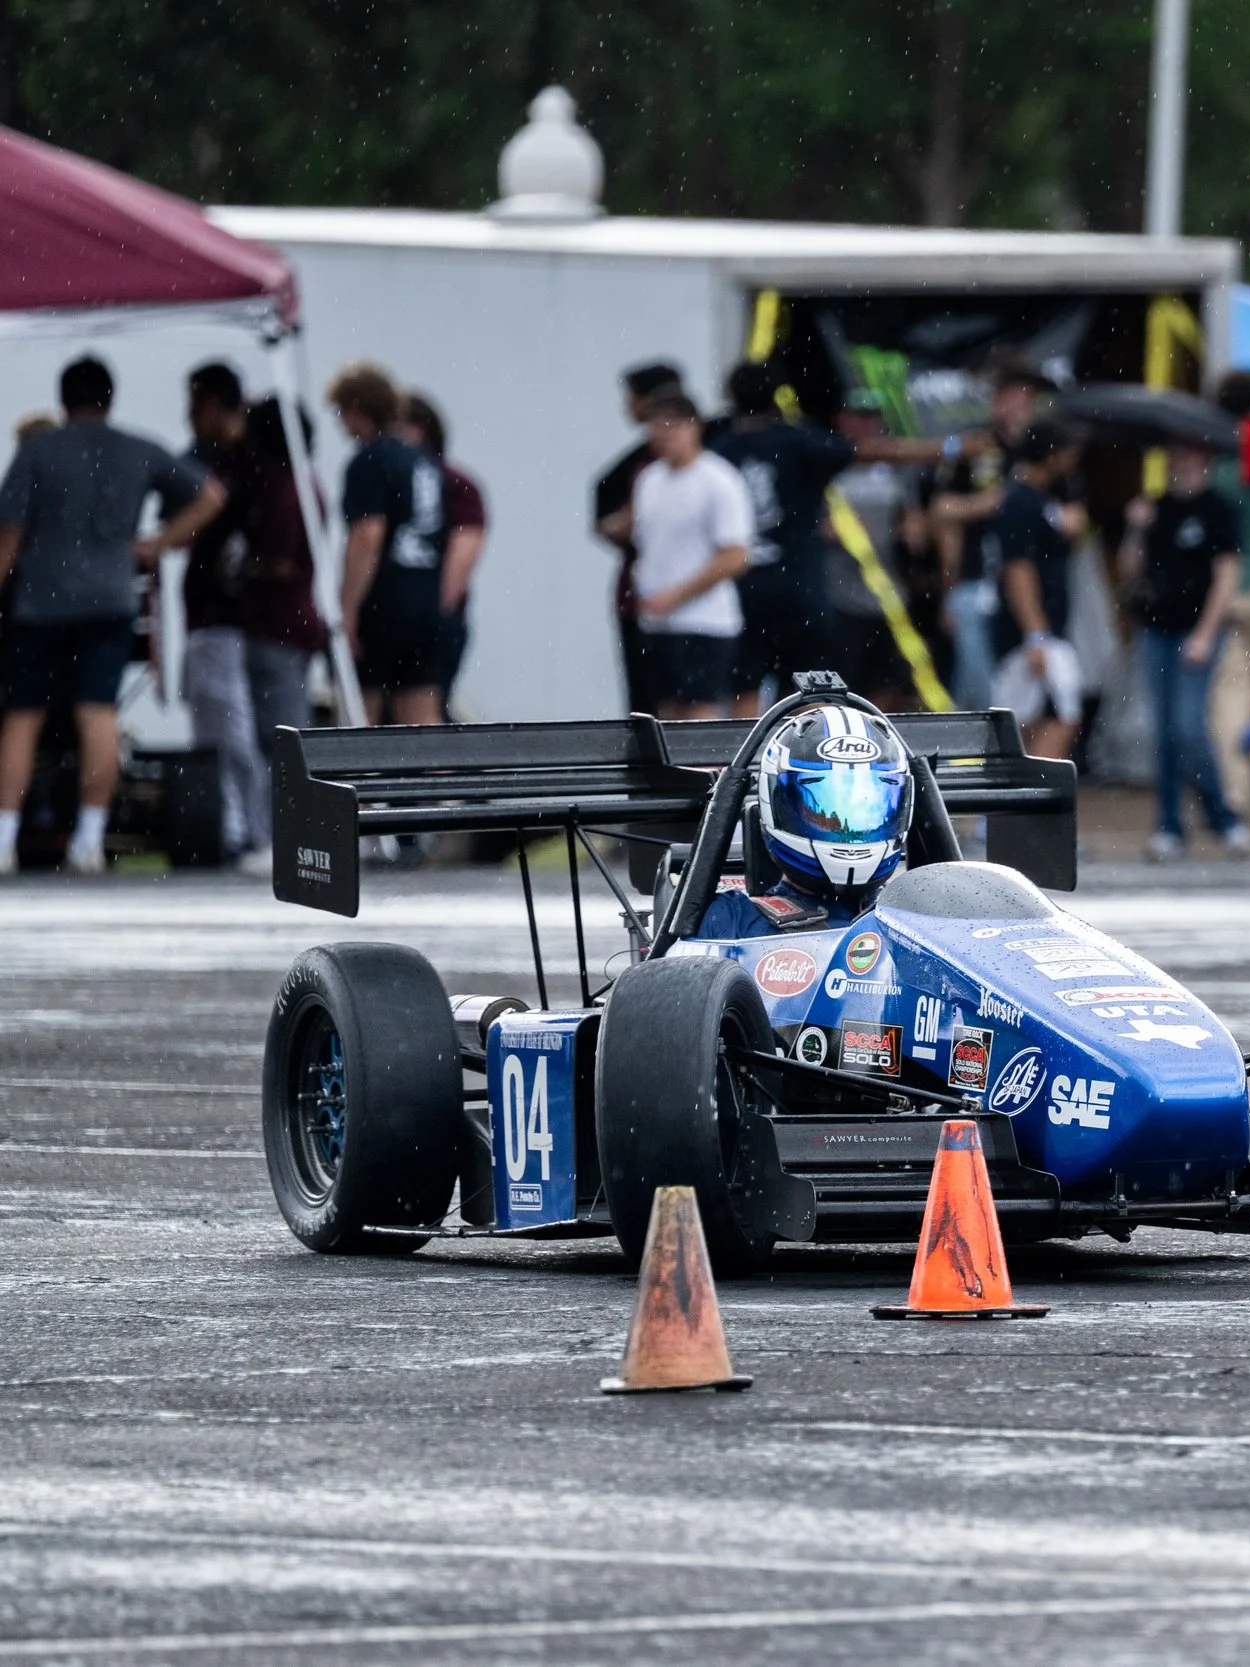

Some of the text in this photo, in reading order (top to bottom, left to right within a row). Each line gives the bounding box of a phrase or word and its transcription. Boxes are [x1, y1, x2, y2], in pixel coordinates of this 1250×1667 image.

[824, 738, 872, 755] Arai
[297, 846, 331, 870] SAWYER
[761, 956, 814, 983] Peterbilt
[846, 982, 903, 996] HALLIBURTON
[914, 995, 941, 1044] GM
[1091, 1004, 1189, 1018] UTA
[844, 1031, 892, 1051] SCCA
[843, 1052, 892, 1067] SOLO
[956, 1044, 984, 1062] SCCA
[1048, 1074, 1116, 1130] SAE
[502, 1054, 554, 1182] 04
[823, 1135, 913, 1143] SAWYER composite
